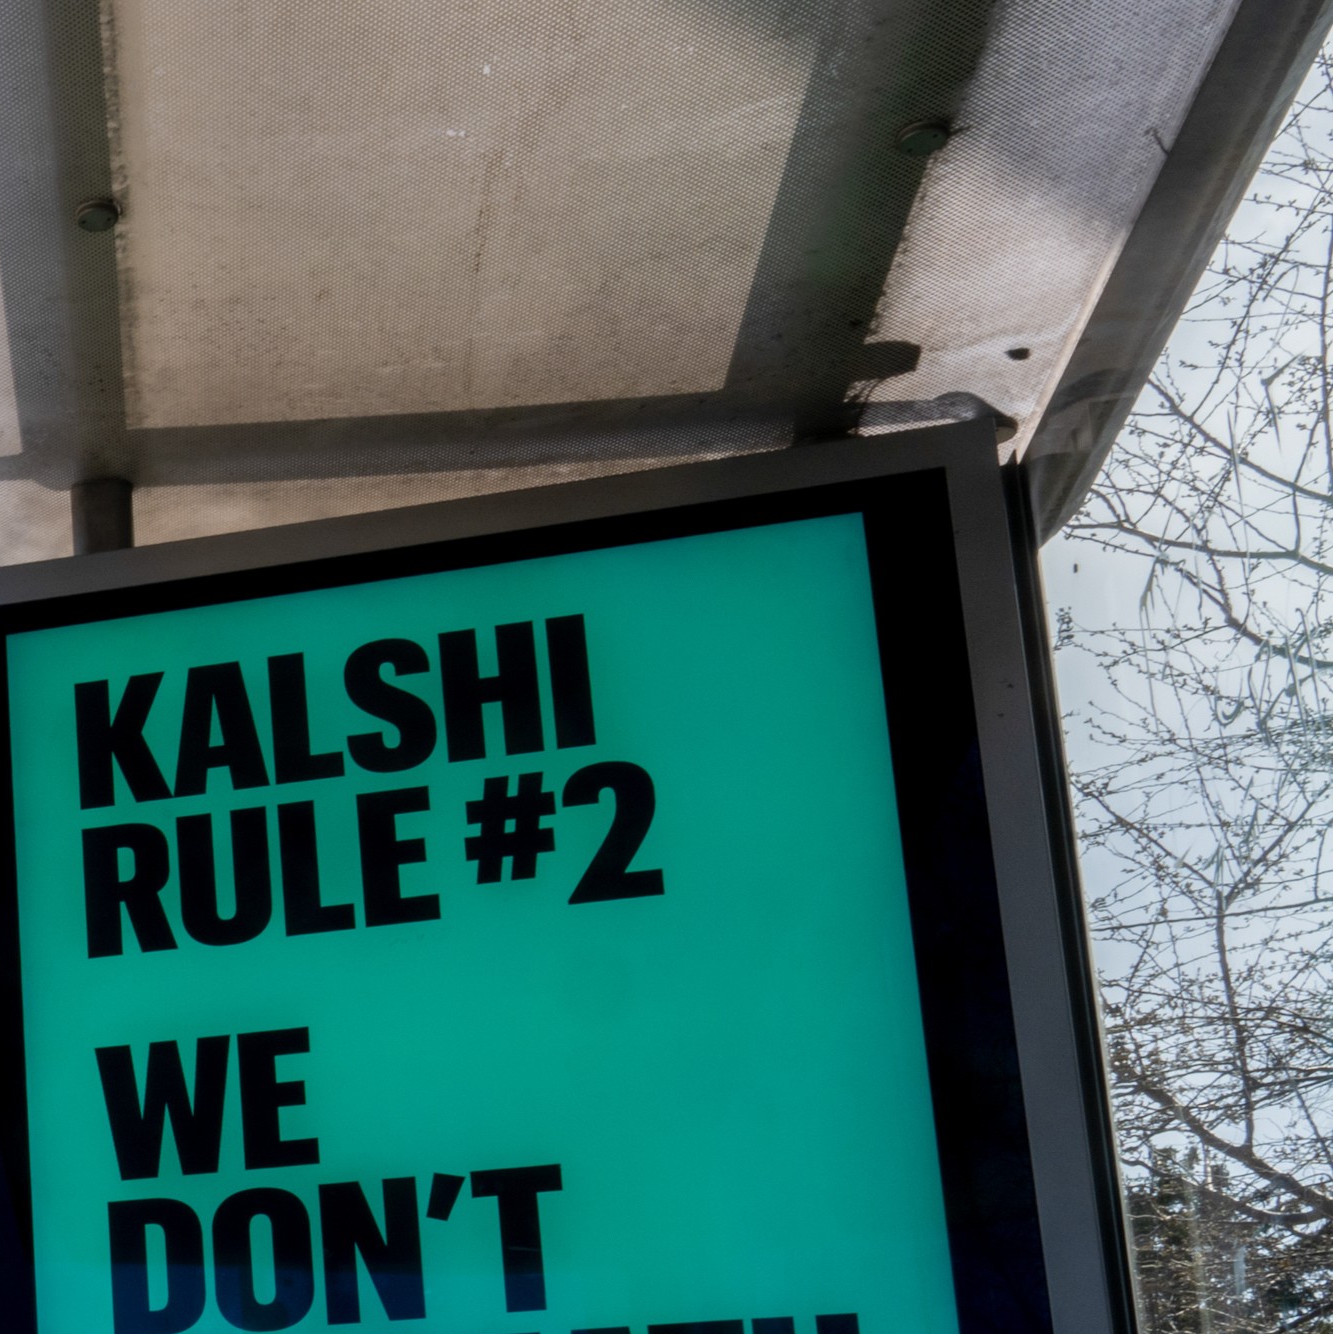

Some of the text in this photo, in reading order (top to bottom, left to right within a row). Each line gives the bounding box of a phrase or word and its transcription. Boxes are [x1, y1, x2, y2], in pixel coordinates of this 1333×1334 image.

[74, 613, 597, 810] KALSHI
[81, 760, 665, 959] RULE #2
[94, 1025, 321, 1182] WE
